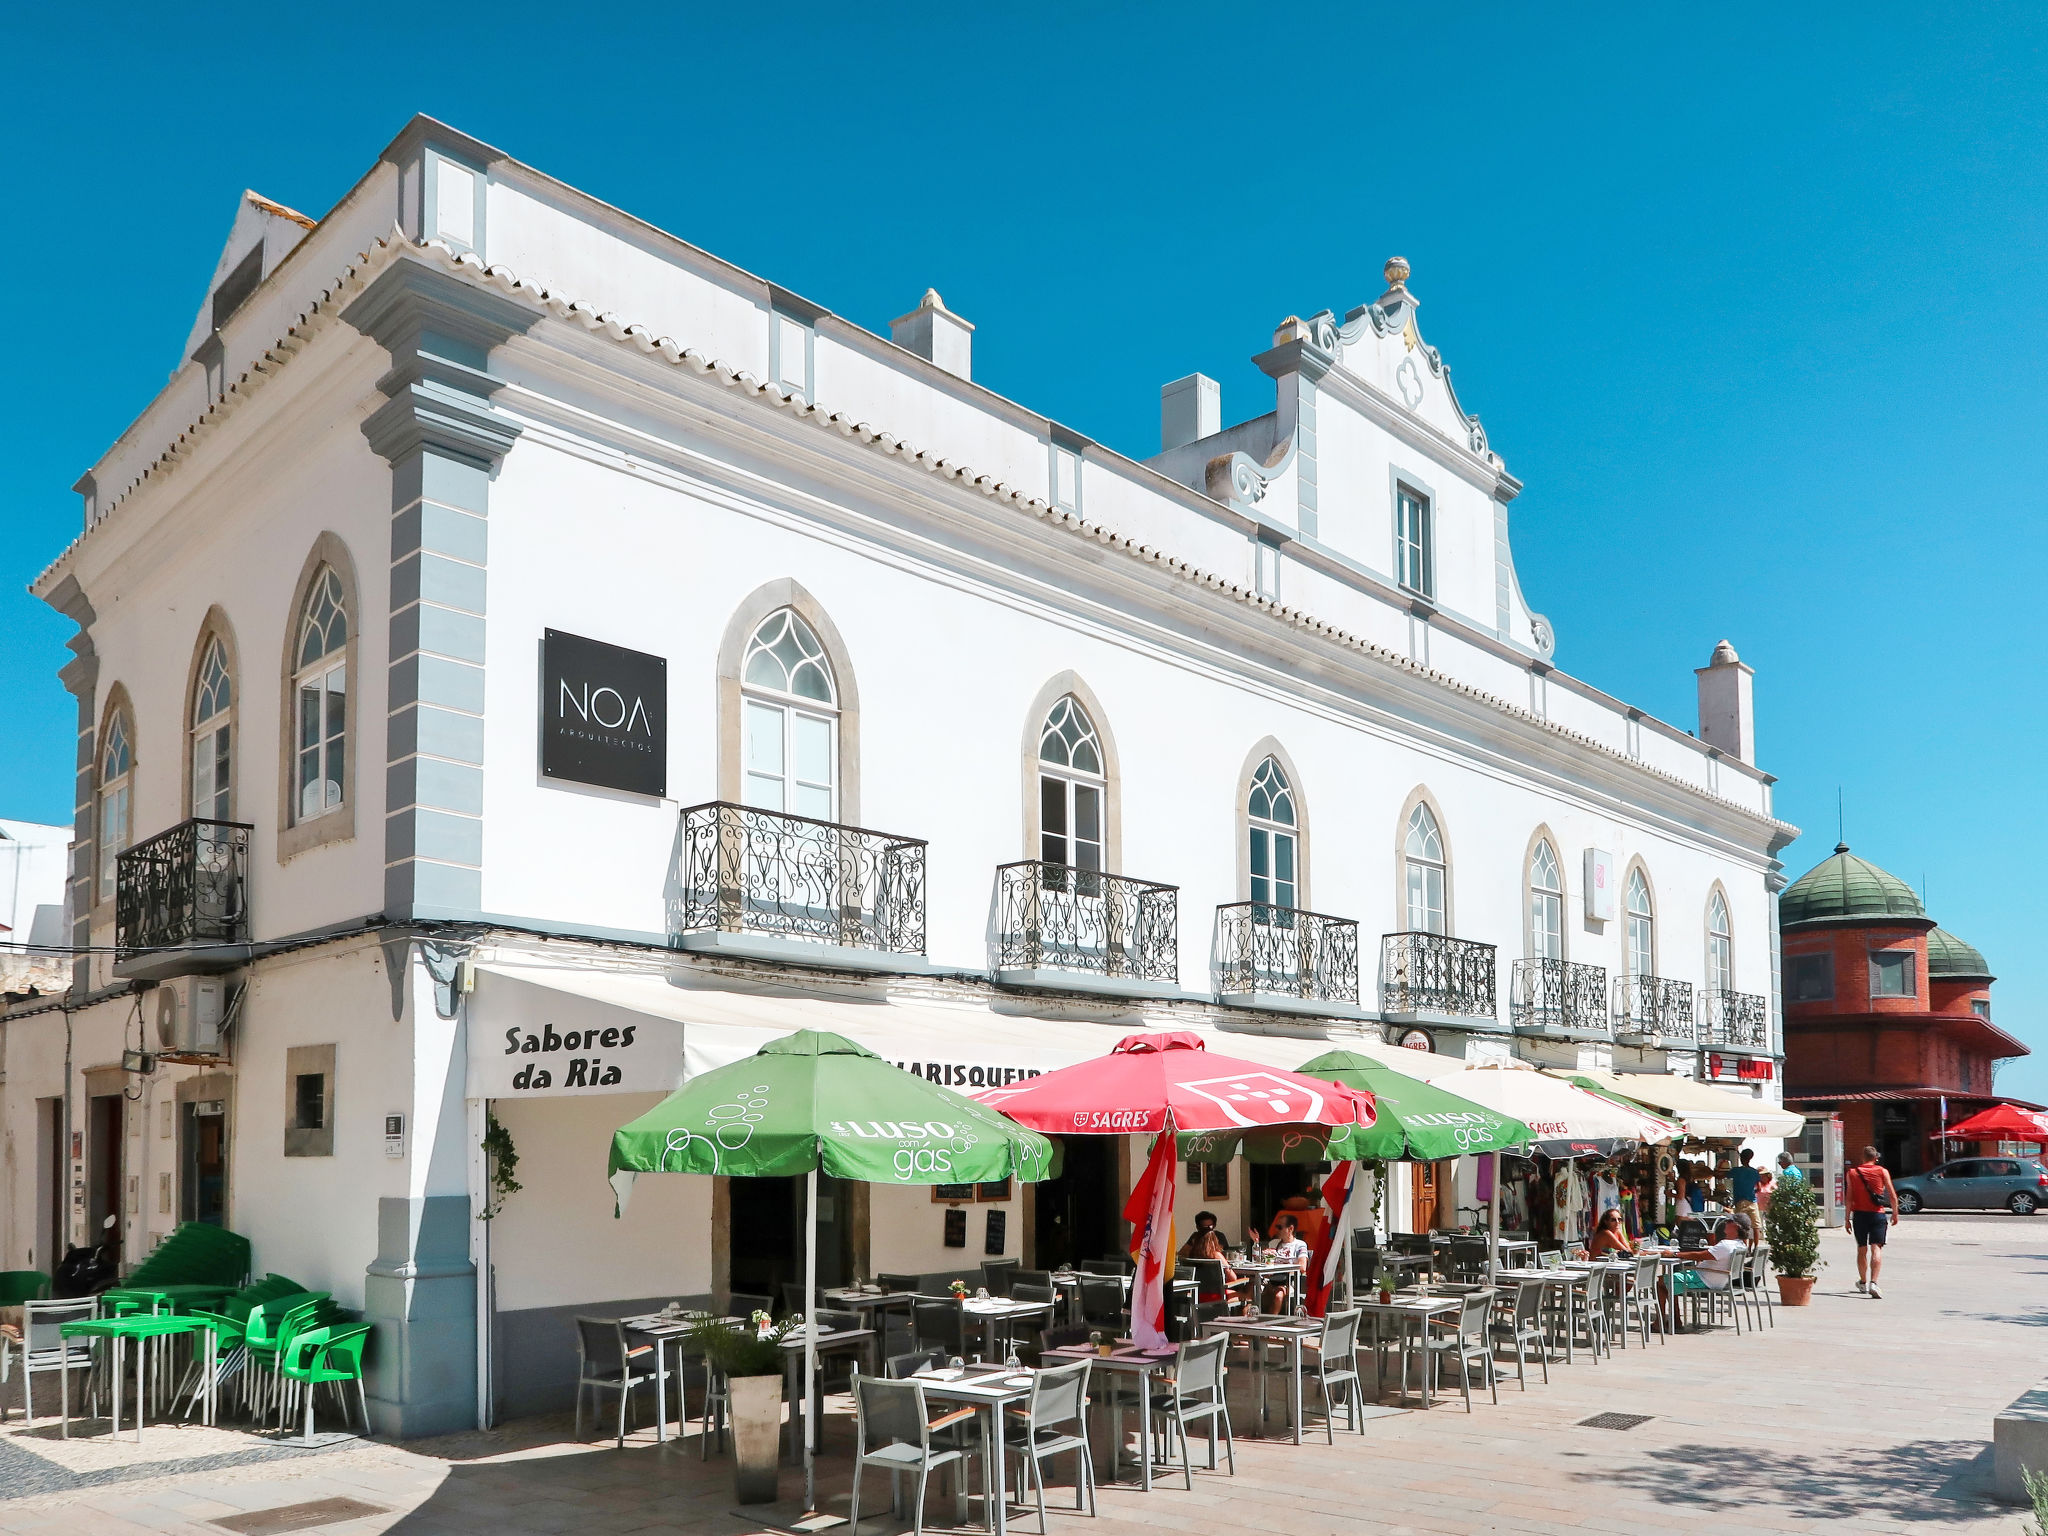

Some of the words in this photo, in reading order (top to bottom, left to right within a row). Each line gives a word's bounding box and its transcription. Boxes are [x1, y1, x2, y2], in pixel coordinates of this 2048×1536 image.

[560, 677, 651, 737] NOA
[560, 727, 652, 753] ARQUITECTOS
[504, 1023, 637, 1055] Sabores
[512, 1063, 552, 1090] da
[564, 1058, 622, 1088] Ria
[846, 1120, 955, 1140] LUSO
[1090, 1110, 1151, 1128] SAGRES
[1412, 1112, 1485, 1126] LUSO
[1529, 1121, 1568, 1134] SAGRES
[898, 1140, 920, 1148] com
[1454, 1123, 1493, 1150] gás
[893, 1140, 952, 1181] gás
